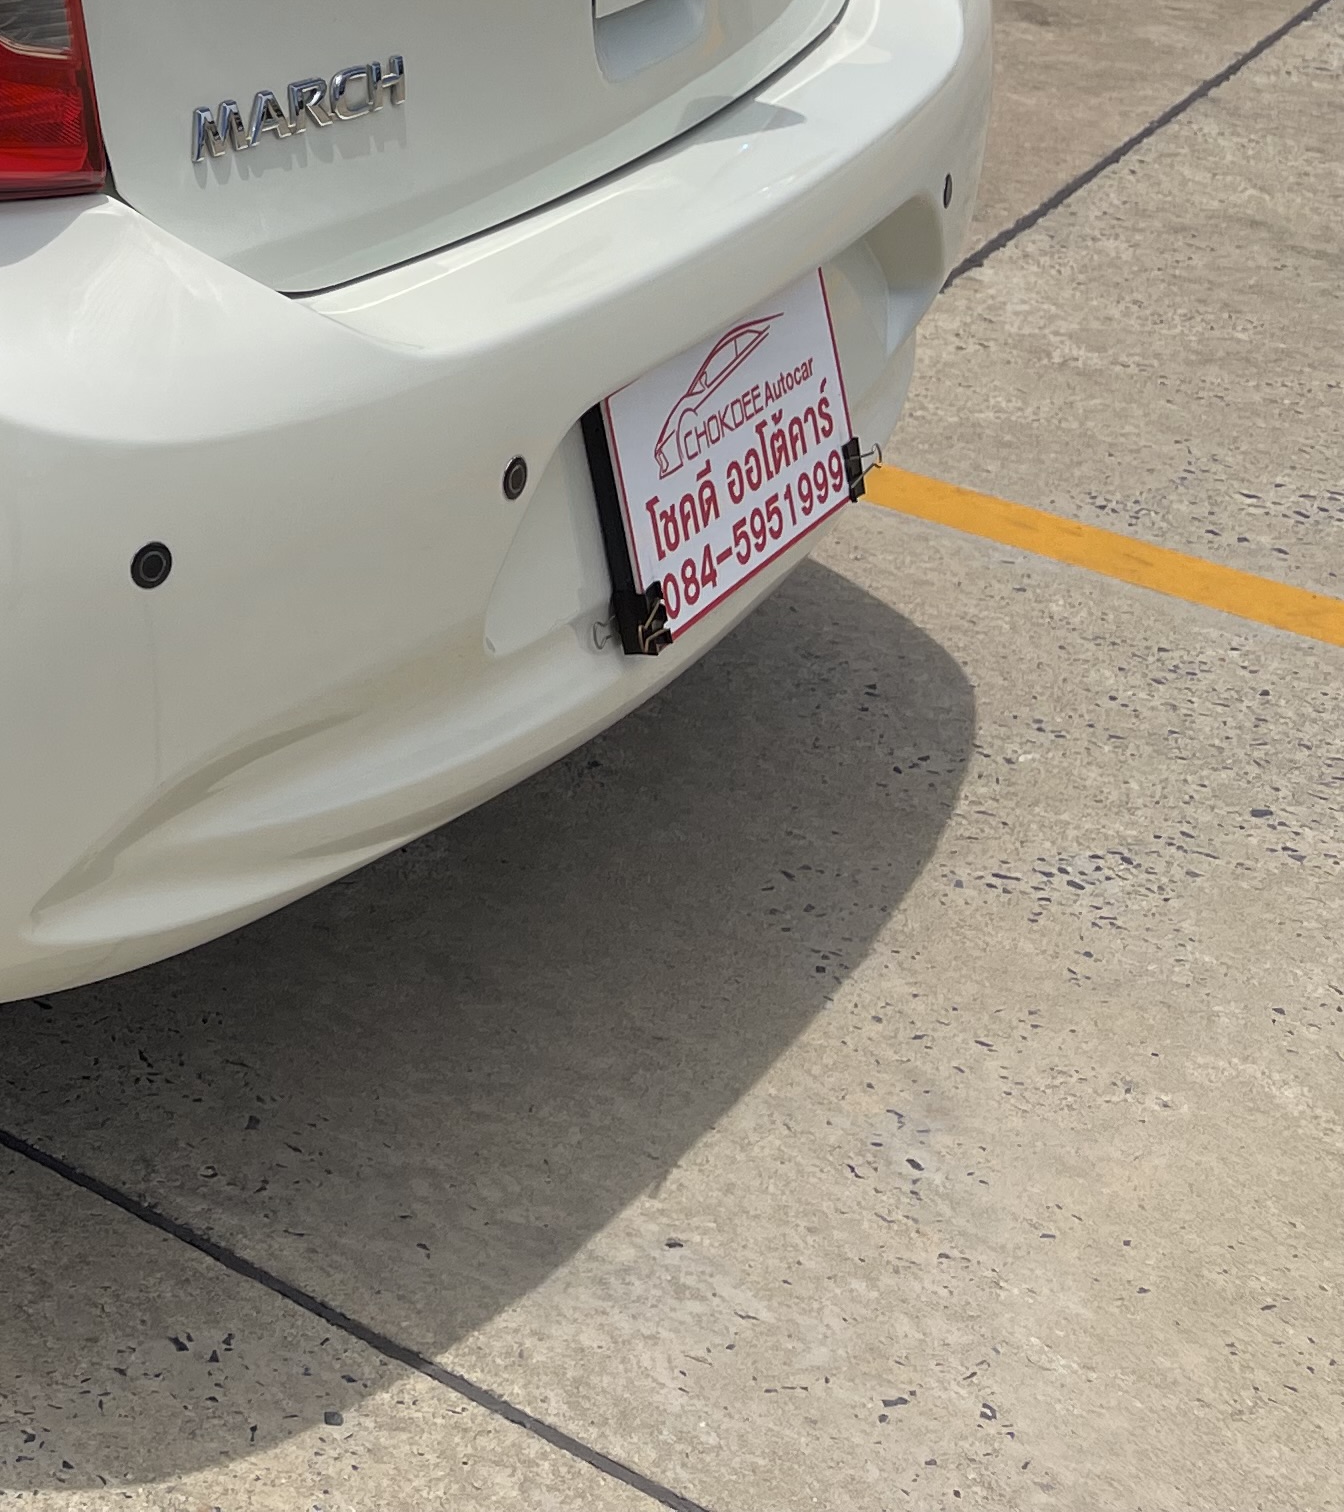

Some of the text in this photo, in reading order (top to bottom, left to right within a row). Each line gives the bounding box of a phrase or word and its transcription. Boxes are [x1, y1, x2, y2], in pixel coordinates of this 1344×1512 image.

[191, 54, 406, 163] MARCH
[683, 357, 815, 462] CHOKDEE Autocar
[646, 459, 722, 562] โชคดี
[662, 449, 846, 620] 084-5951999
